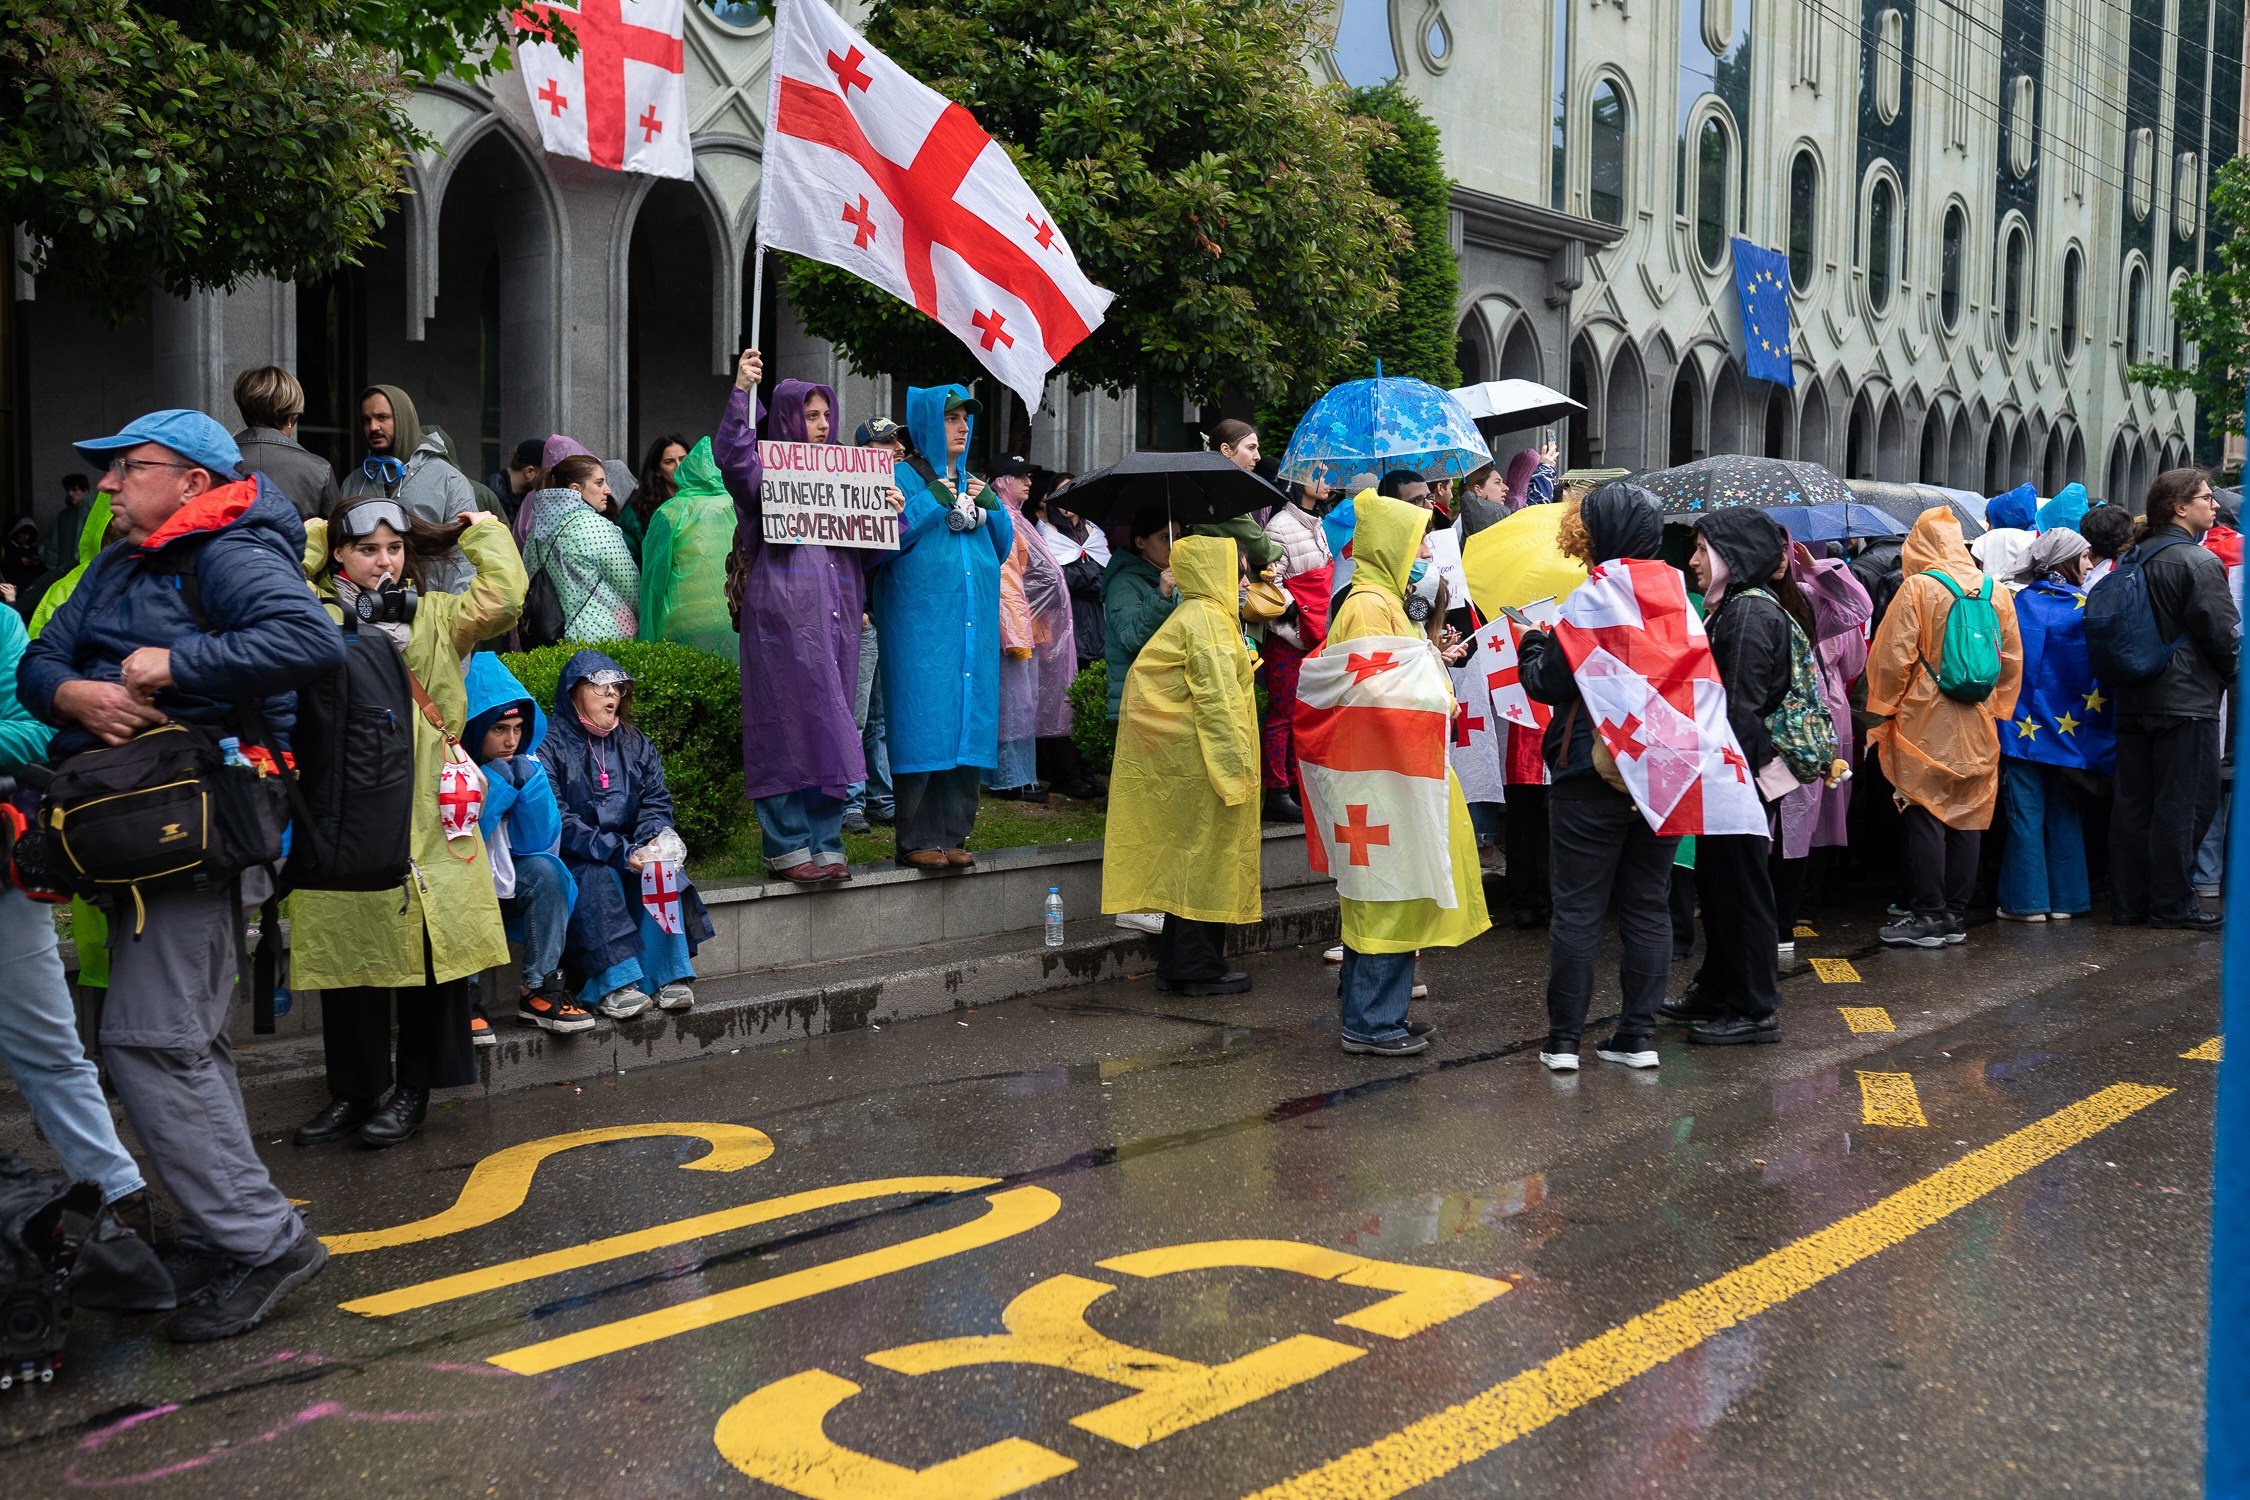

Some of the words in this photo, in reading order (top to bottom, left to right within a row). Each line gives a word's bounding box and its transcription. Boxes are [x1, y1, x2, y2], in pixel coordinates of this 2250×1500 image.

[759, 441, 804, 471] LOVE
[825, 446, 894, 475] COUNTRY
[761, 479, 789, 504] BUT
[791, 481, 836, 507] NEVER
[840, 484, 890, 511] TRUST
[762, 514, 787, 539] ITS
[786, 512, 897, 544] GOVERNMENT
